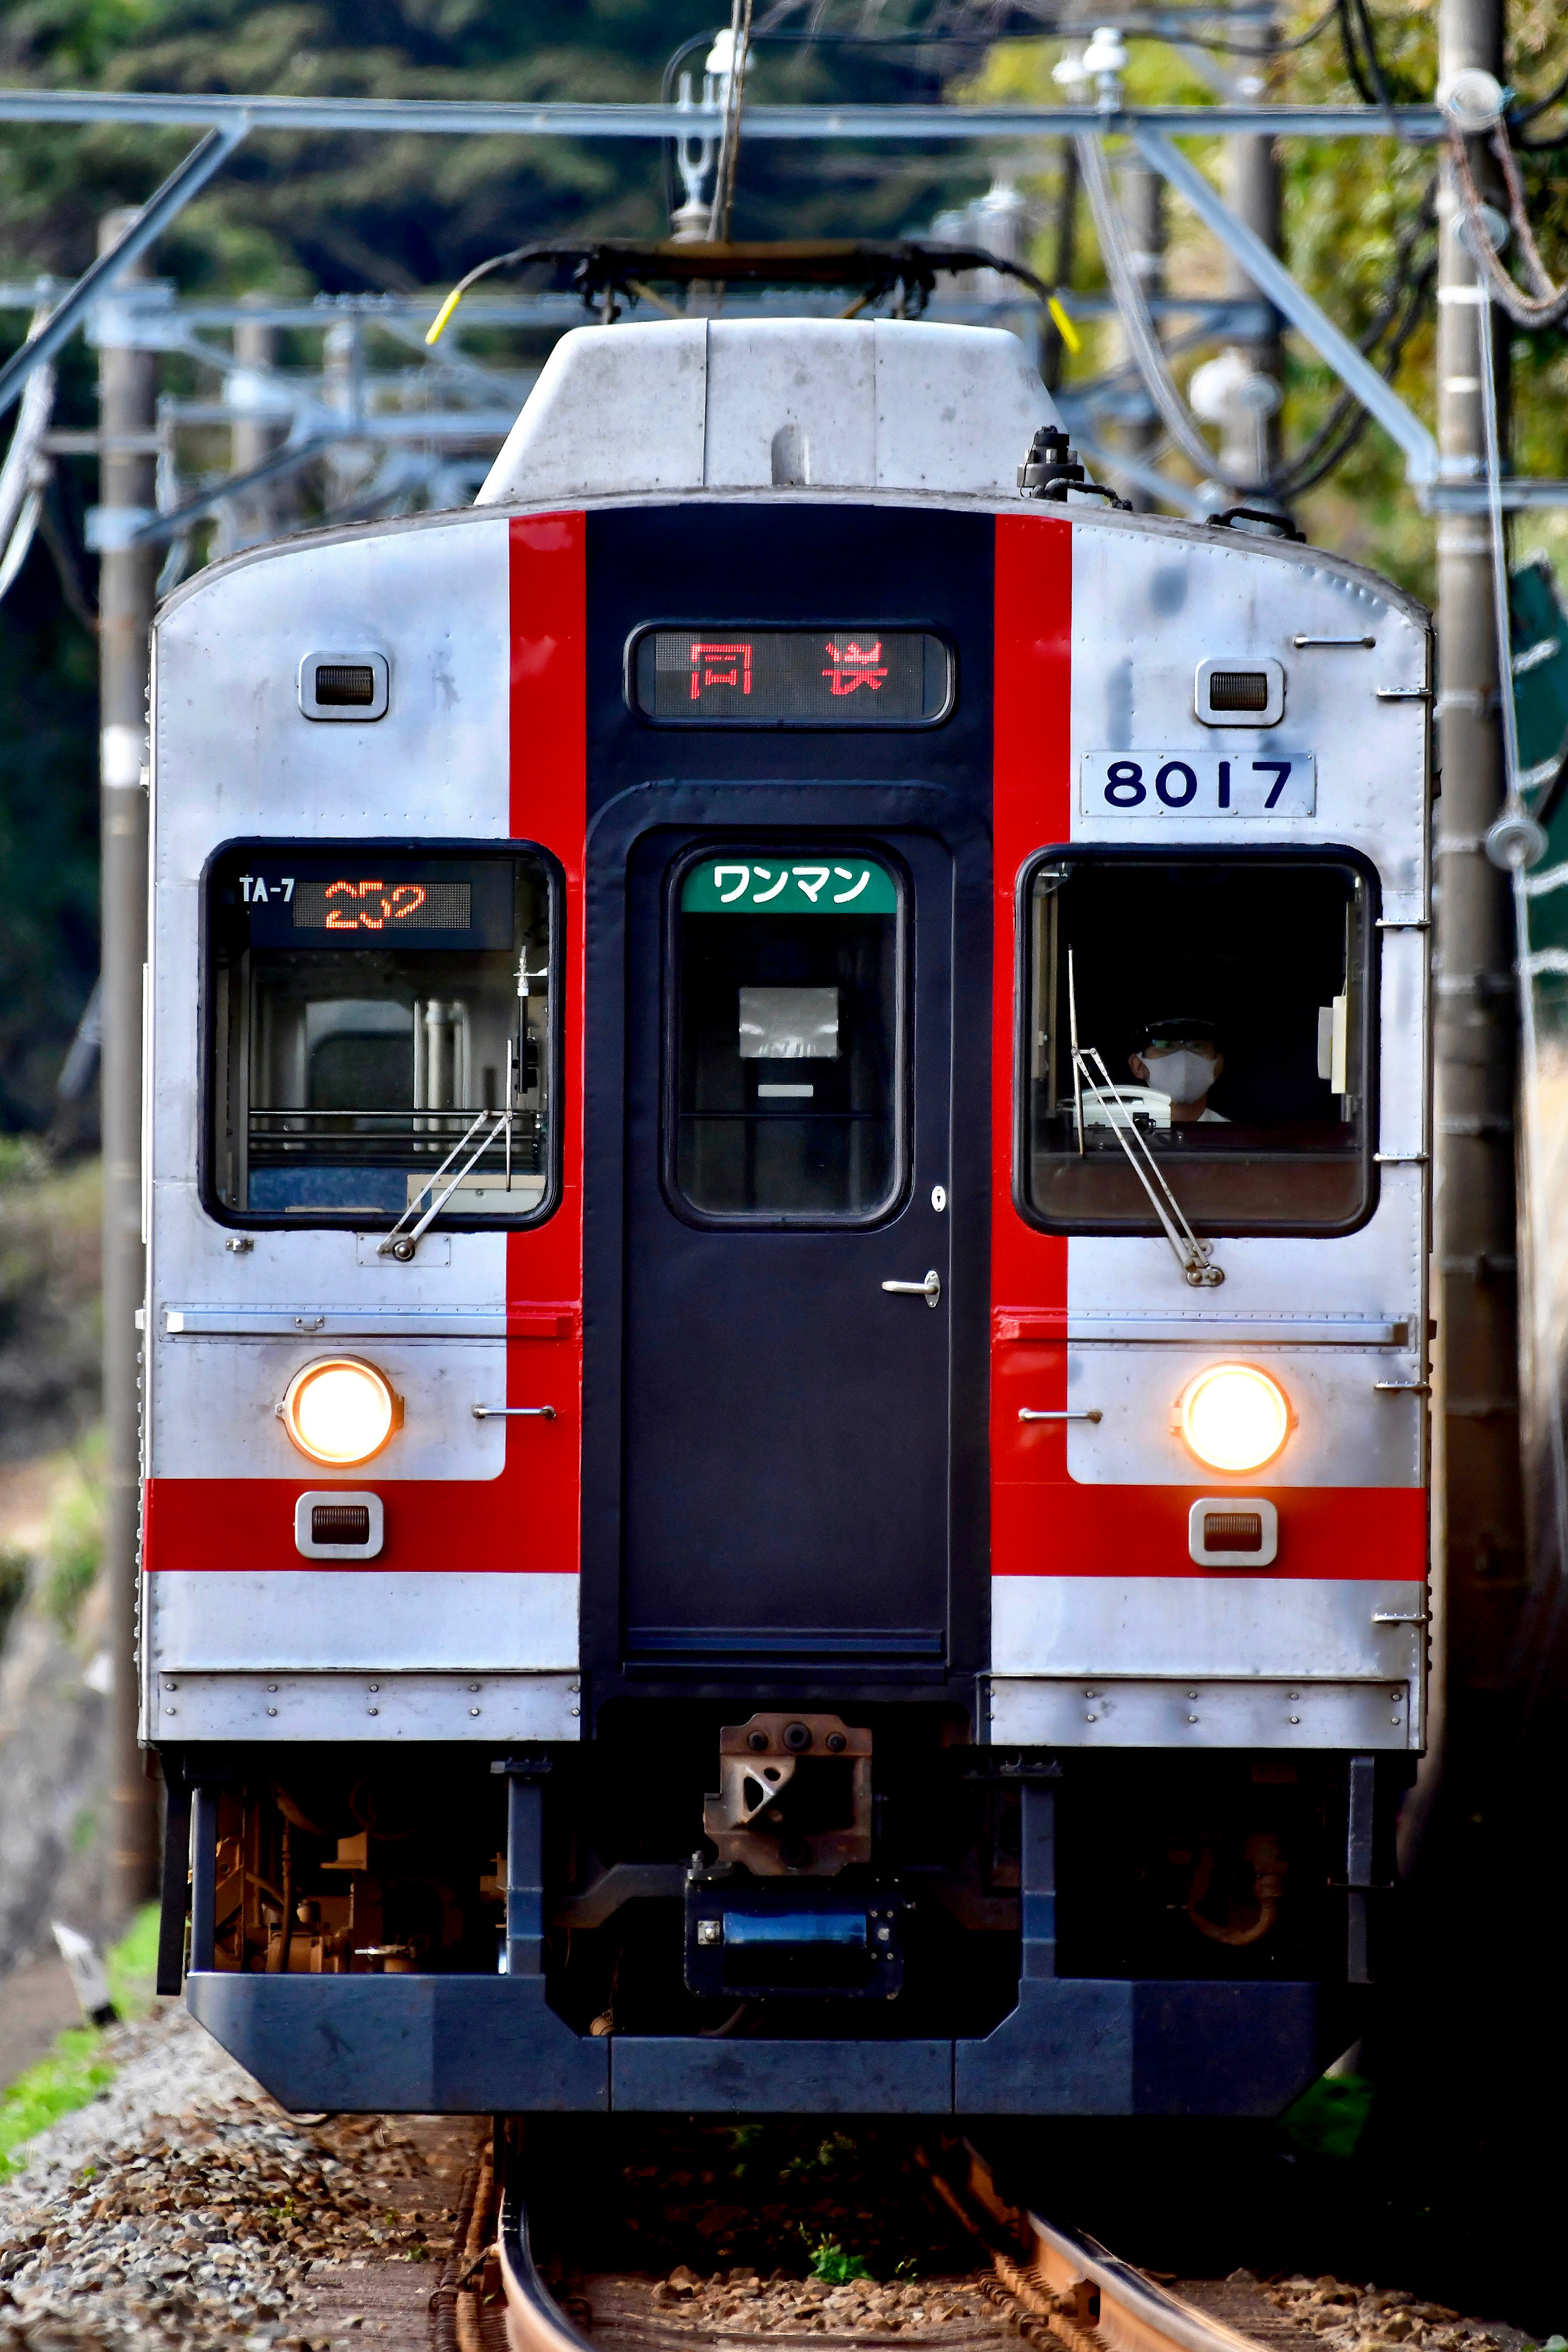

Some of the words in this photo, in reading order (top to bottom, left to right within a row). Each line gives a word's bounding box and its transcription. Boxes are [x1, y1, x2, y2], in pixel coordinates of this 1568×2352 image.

[1104, 761, 1292, 808] 8017
[239, 877, 294, 902] TA-7
[714, 866, 871, 903] ワンマン
